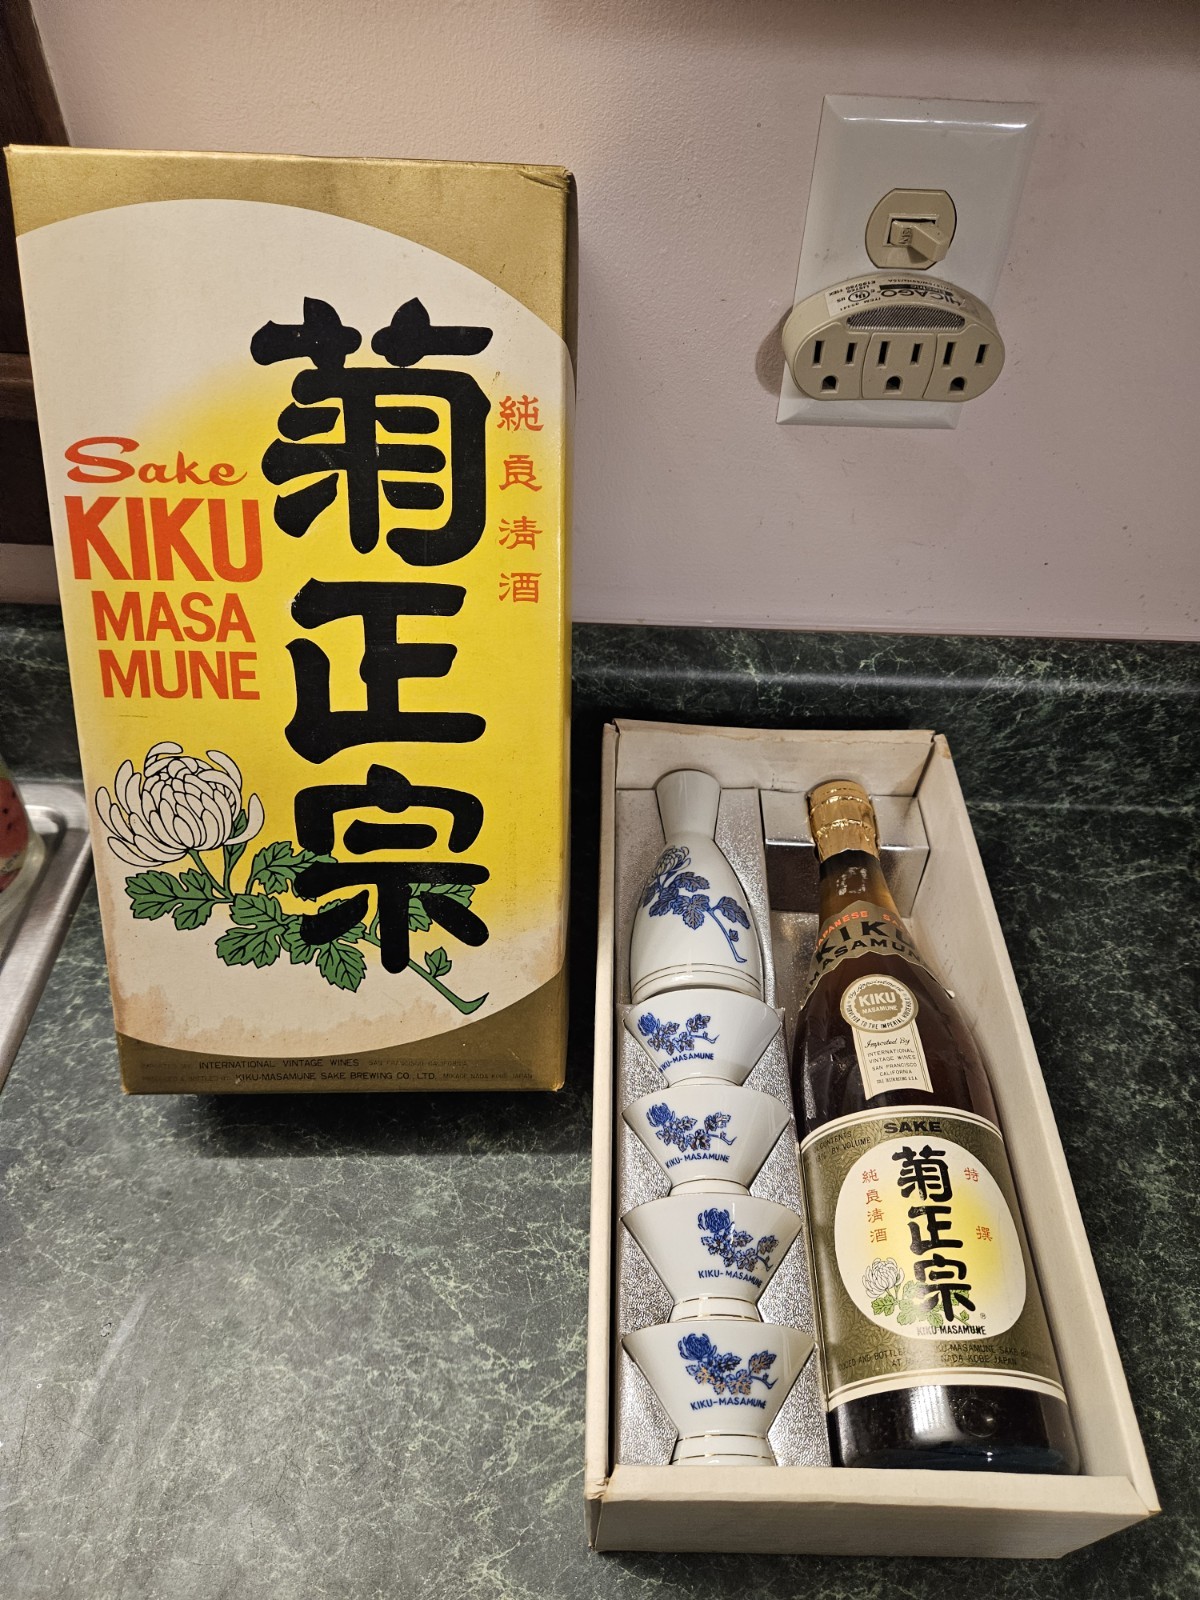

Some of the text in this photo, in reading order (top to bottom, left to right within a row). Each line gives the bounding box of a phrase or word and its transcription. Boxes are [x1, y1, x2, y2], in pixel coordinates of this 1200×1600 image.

[880, 289, 964, 306] HICAGO
[64, 436, 247, 486] Sake
[64, 496, 263, 582] KIKU
[91, 590, 256, 643] MASA
[251, 297, 493, 973] 菊正宗
[98, 649, 260, 699] MUNE
[808, 938, 922, 986] MASAMUN
[858, 992, 897, 1007] KIKU
[861, 1004, 898, 1014] MASAMUNE
[868, 1022, 879, 1030] THE
[864, 1036, 911, 1049] Imported By
[867, 1048, 915, 1058] INTERNATIONAL
[868, 1056, 895, 1064] VINTAGE
[199, 1058, 276, 1070] INTERNATIONAL
[282, 1058, 323, 1068] VINTAGE
[329, 1058, 360, 1067] WINES
[235, 1072, 316, 1083] KIKU-MASAMUNE
[320, 1072, 346, 1081] SAKE
[350, 1072, 393, 1081] BREWING
[879, 1069, 913, 1077] CALIFORNIA
[883, 1120, 943, 1134] SAKE
[831, 1136, 872, 1155] BY VOLUME
[963, 1167, 993, 1242] 特撰
[891, 1144, 976, 1322] 菊正宗
[857, 1353, 872, 1364] AND
[967, 1354, 990, 1363] KOBE
[994, 1356, 1018, 1366] JAPAN
[690, 1397, 767, 1411] KIKU-MASAMUNE
